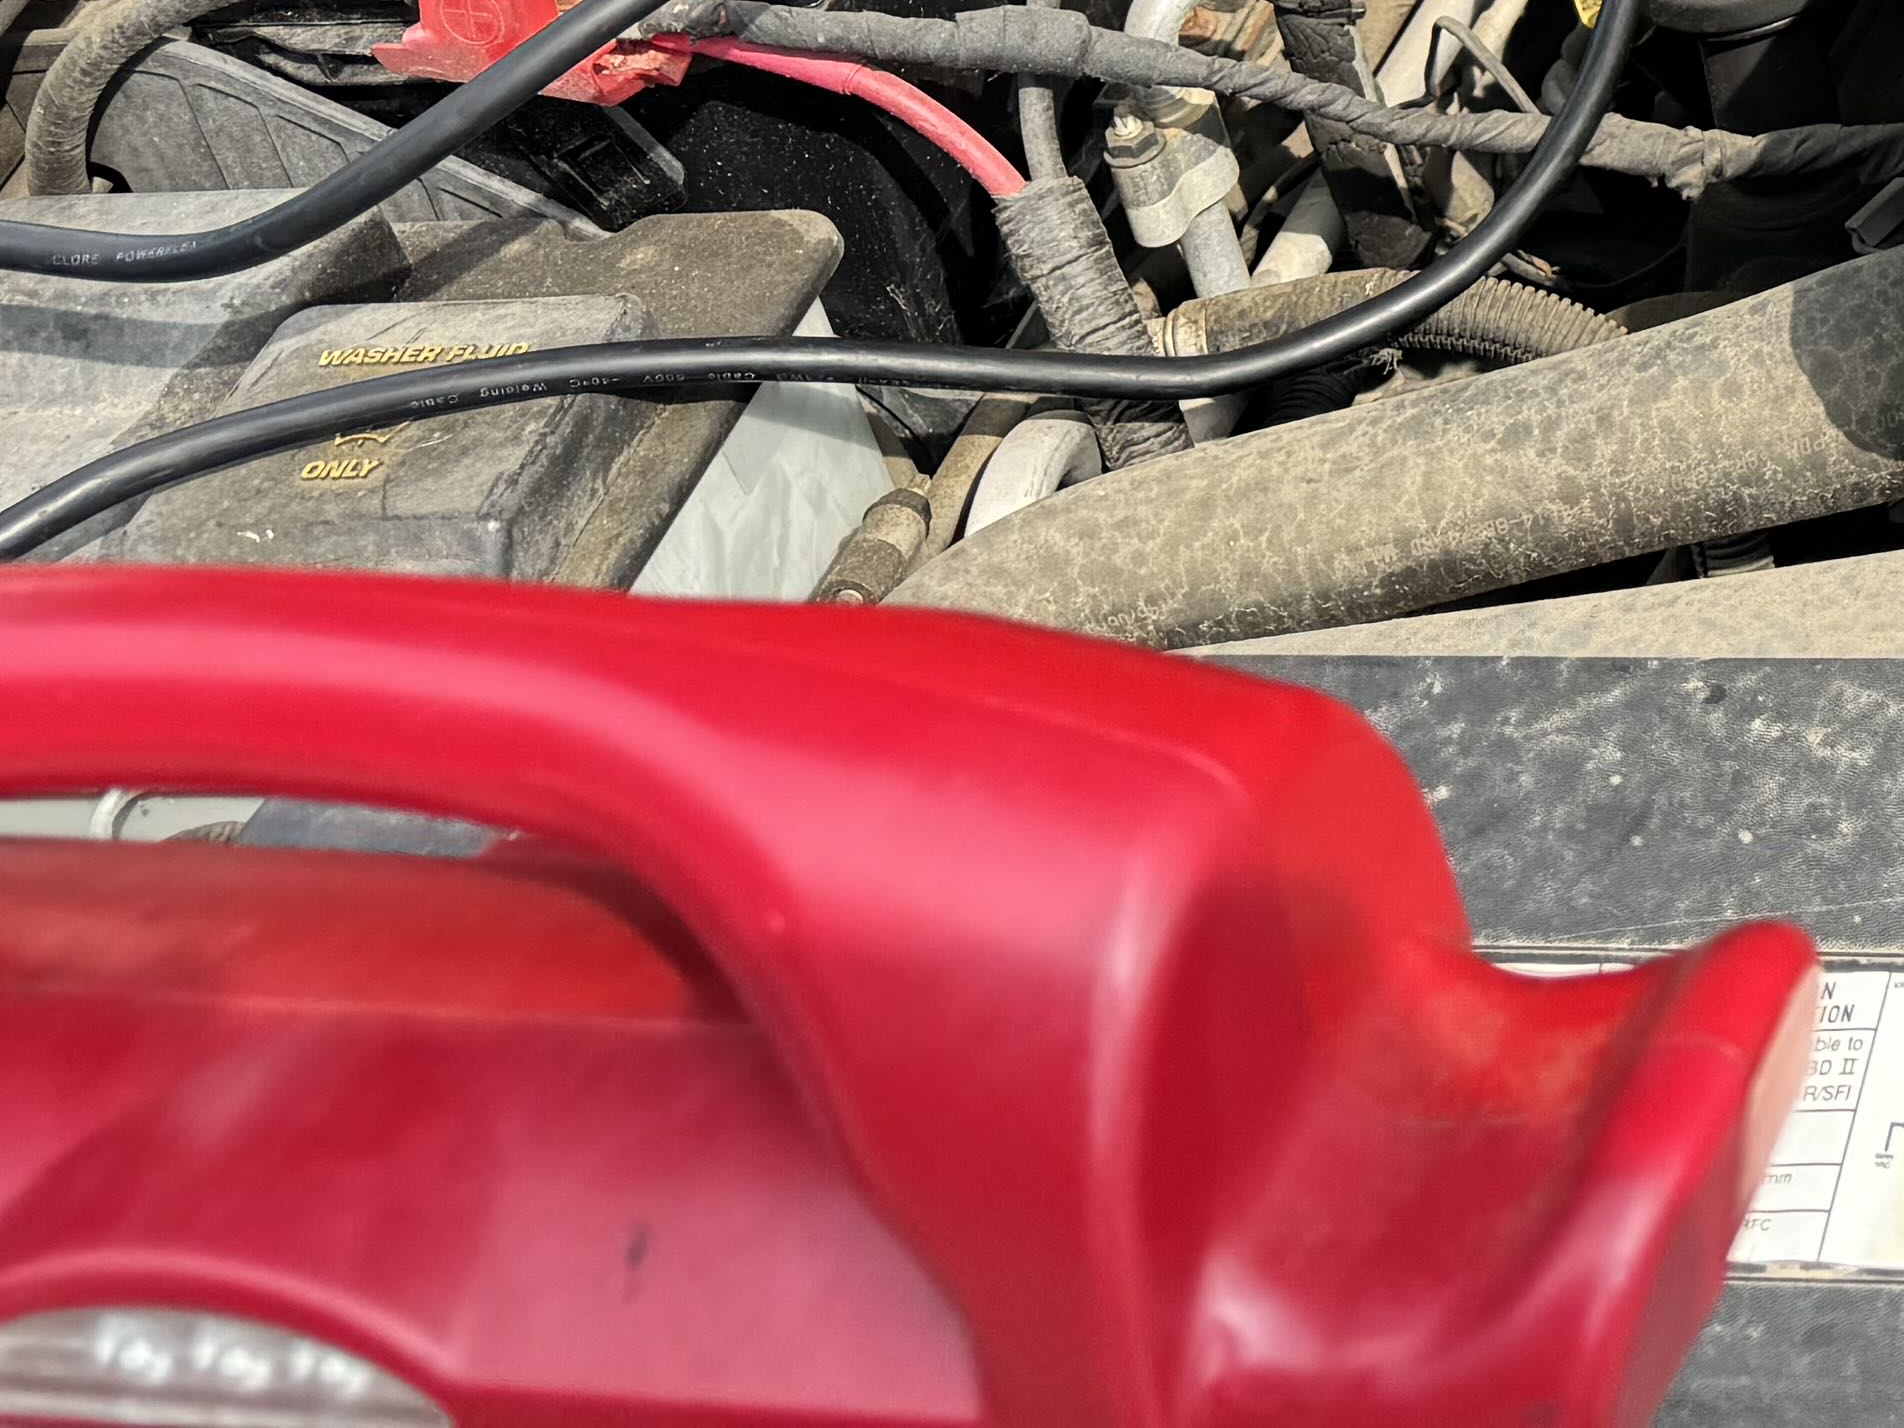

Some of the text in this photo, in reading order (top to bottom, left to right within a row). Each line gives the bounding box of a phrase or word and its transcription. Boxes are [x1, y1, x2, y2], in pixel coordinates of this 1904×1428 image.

[52, 253, 99, 266] CLORE
[318, 344, 444, 366] WASHER
[300, 458, 383, 480] ONLY
[1848, 1037, 1863, 1051] to
